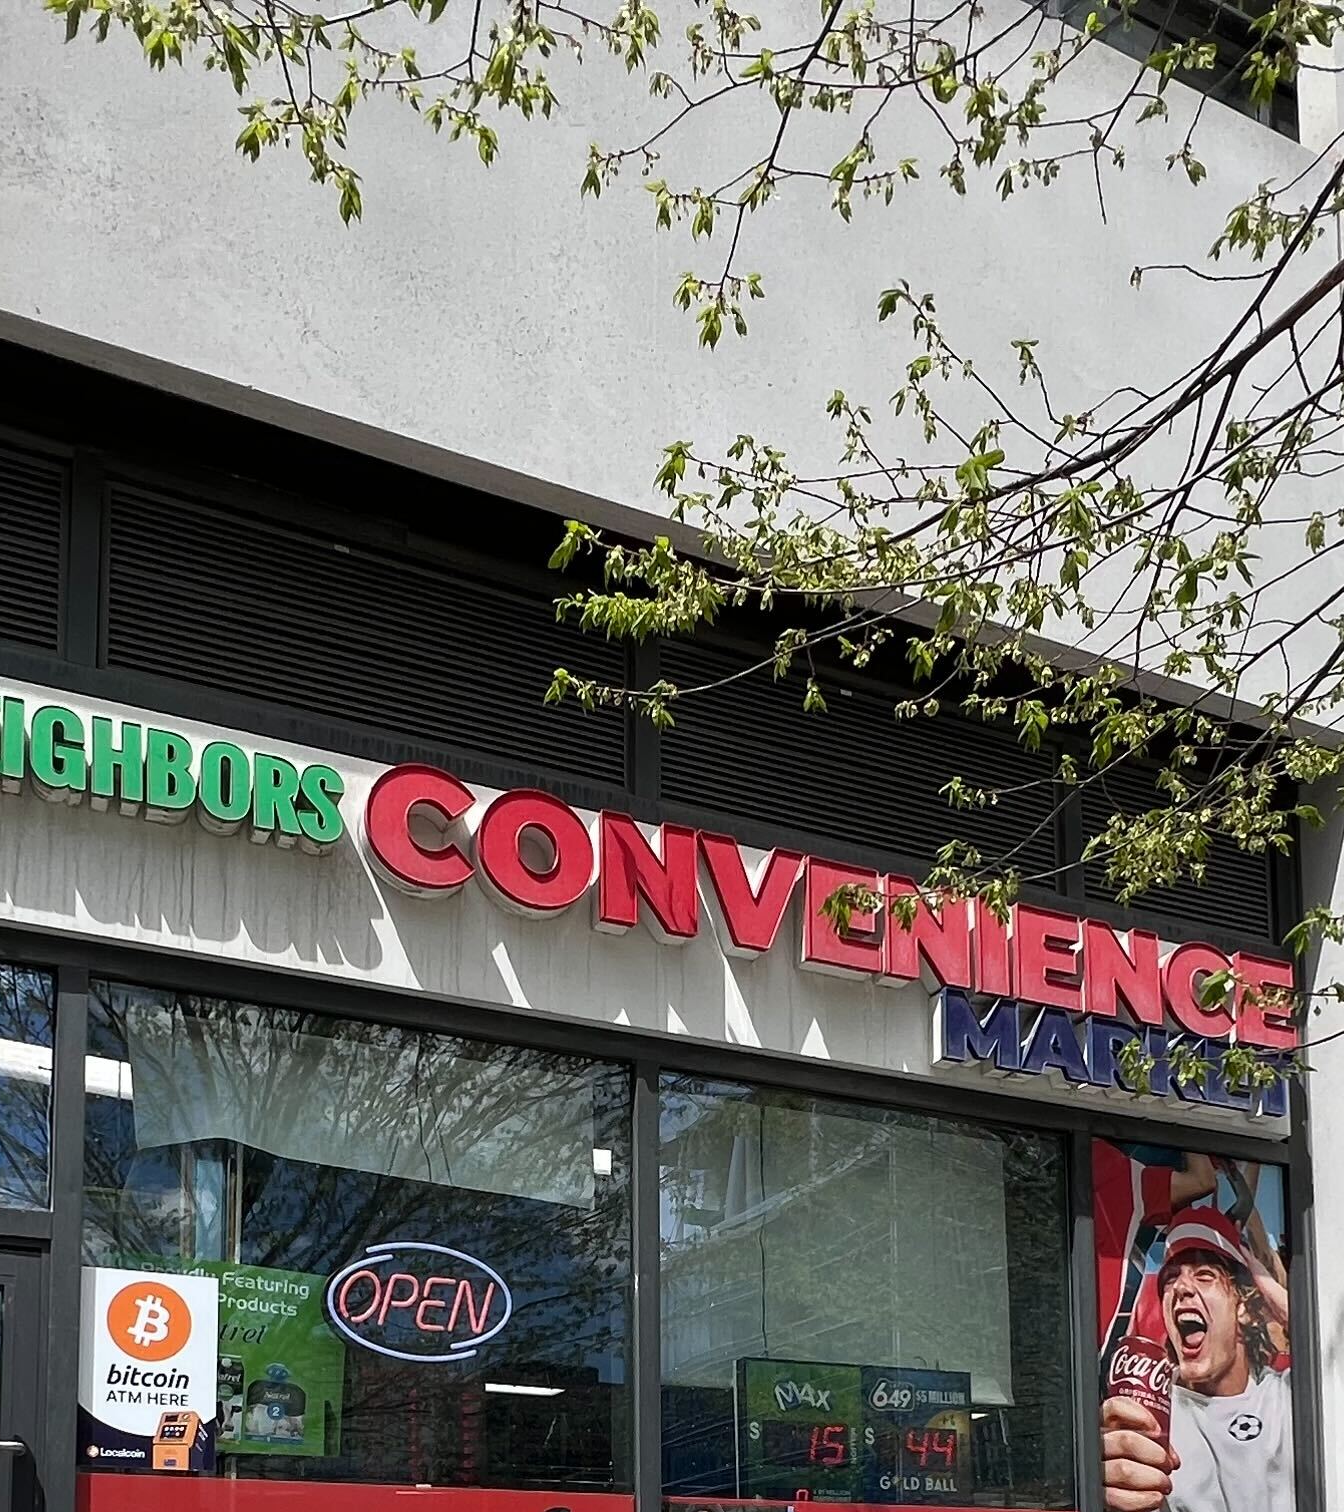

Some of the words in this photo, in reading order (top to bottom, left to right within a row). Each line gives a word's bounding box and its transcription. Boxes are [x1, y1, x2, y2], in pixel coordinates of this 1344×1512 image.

[364, 762, 1299, 1050] CONVENIENCE
[223, 1271, 311, 1299] Featuring
[218, 1292, 299, 1316] Products
[338, 1268, 496, 1334] OPEN
[219, 1323, 267, 1345] trel
[107, 1364, 190, 1389] bitcoin
[106, 1390, 142, 1404] ATM
[147, 1392, 190, 1407] HERE
[774, 1380, 833, 1412] MAX
[871, 1381, 913, 1409] 649
[271, 1406, 281, 1417] 2
[809, 1425, 845, 1467] 15
[906, 1429, 955, 1468] 44
[925, 1477, 959, 1492] BALL
